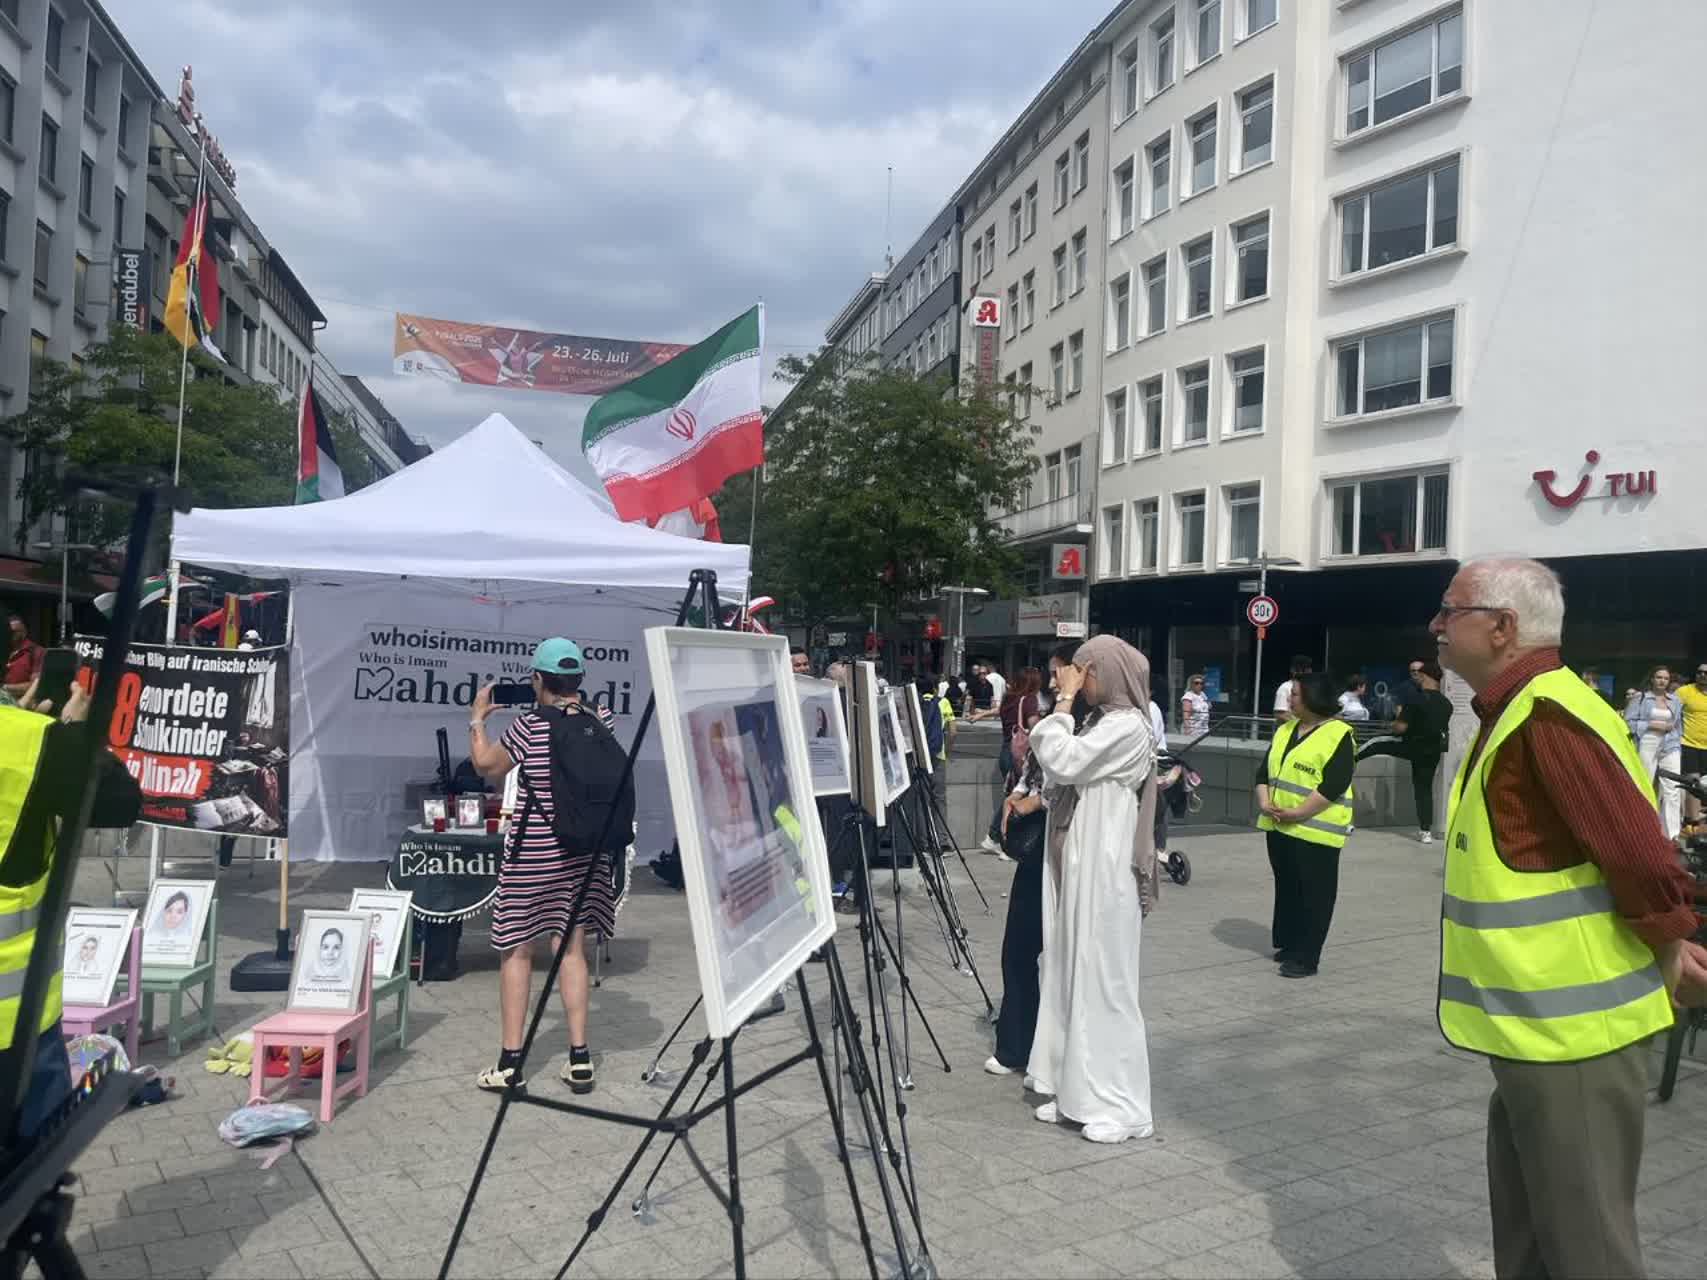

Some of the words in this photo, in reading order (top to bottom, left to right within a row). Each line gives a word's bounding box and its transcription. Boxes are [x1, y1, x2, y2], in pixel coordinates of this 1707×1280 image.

[603, 350, 630, 364] Juli
[1605, 470, 1657, 497] TUI
[168, 654, 190, 671] auf
[192, 655, 246, 673] iranische
[359, 651, 391, 664] Who
[394, 653, 405, 665] is
[408, 656, 448, 668] Imam
[399, 850, 498, 877] Mahdi
